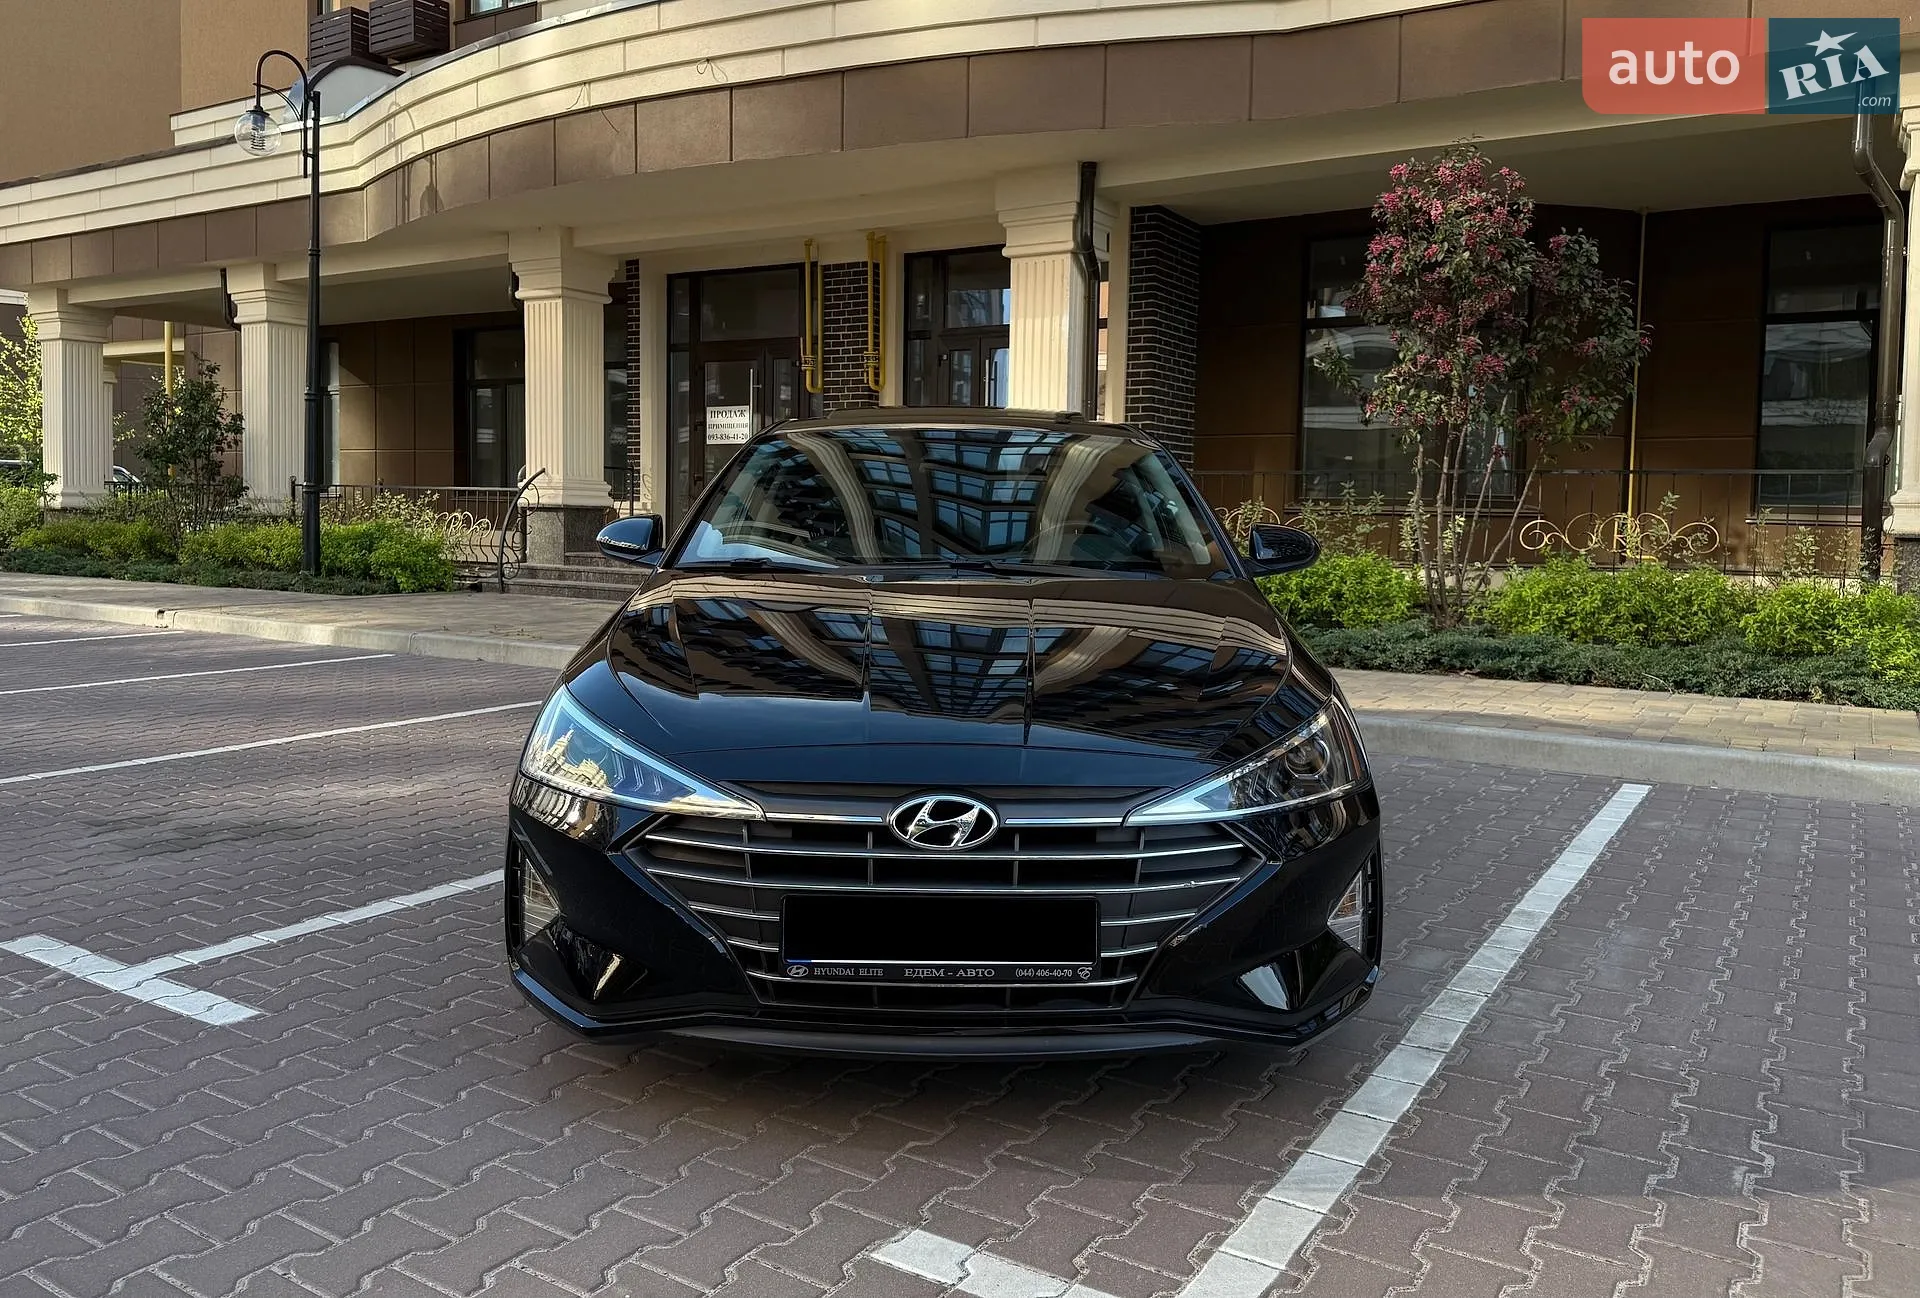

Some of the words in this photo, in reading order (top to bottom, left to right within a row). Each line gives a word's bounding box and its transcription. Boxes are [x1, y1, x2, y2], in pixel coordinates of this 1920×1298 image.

[710, 409, 747, 419] ПРОДАЖ
[814, 967, 855, 976] HYUNDAI
[859, 968, 884, 976] ELITE
[904, 968, 945, 978] ЕДЕМ
[956, 968, 995, 977] АВТО
[1015, 968, 1035, 977] (044)
[1035, 968, 1073, 977] 406-40-70
